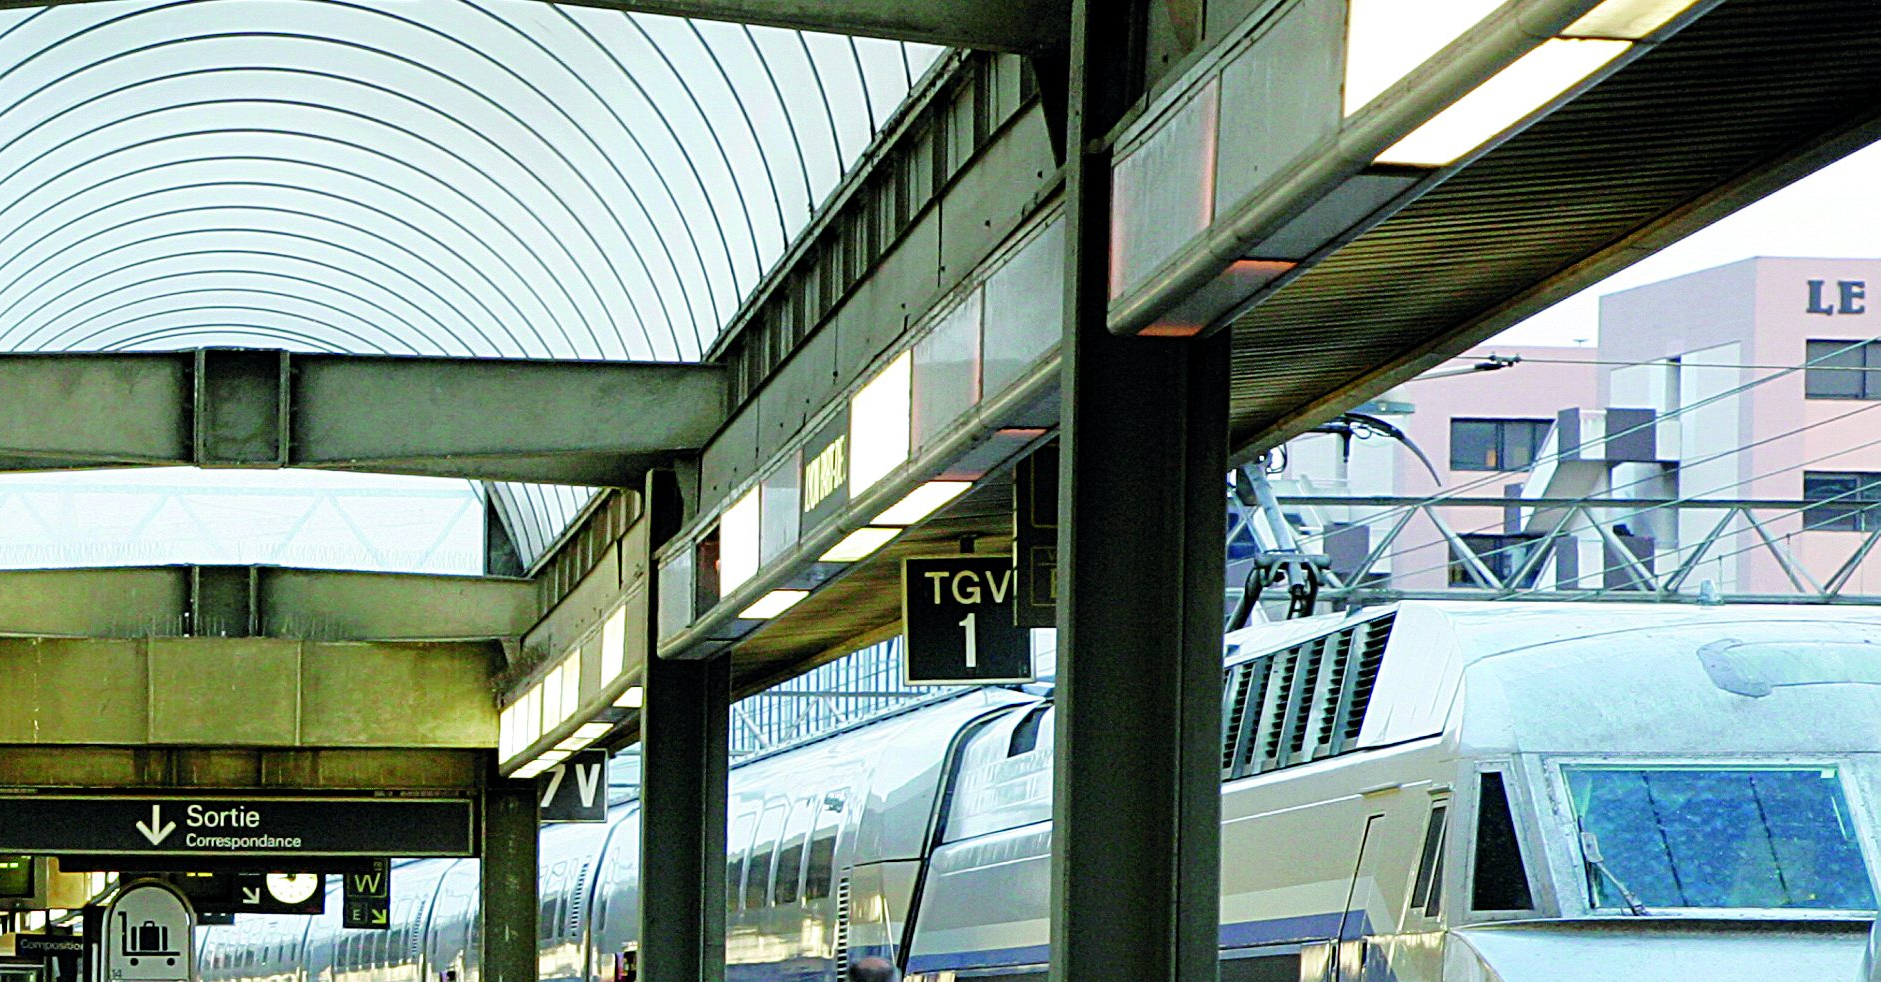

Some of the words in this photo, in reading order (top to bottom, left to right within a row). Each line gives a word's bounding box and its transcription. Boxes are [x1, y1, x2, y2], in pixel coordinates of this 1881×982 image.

[1806, 280, 1865, 316] LE
[924, 570, 1011, 604] TGV
[958, 612, 977, 668] 1
[186, 804, 260, 828] Sortie
[185, 832, 302, 850] Correspondance
[354, 872, 381, 893] W
